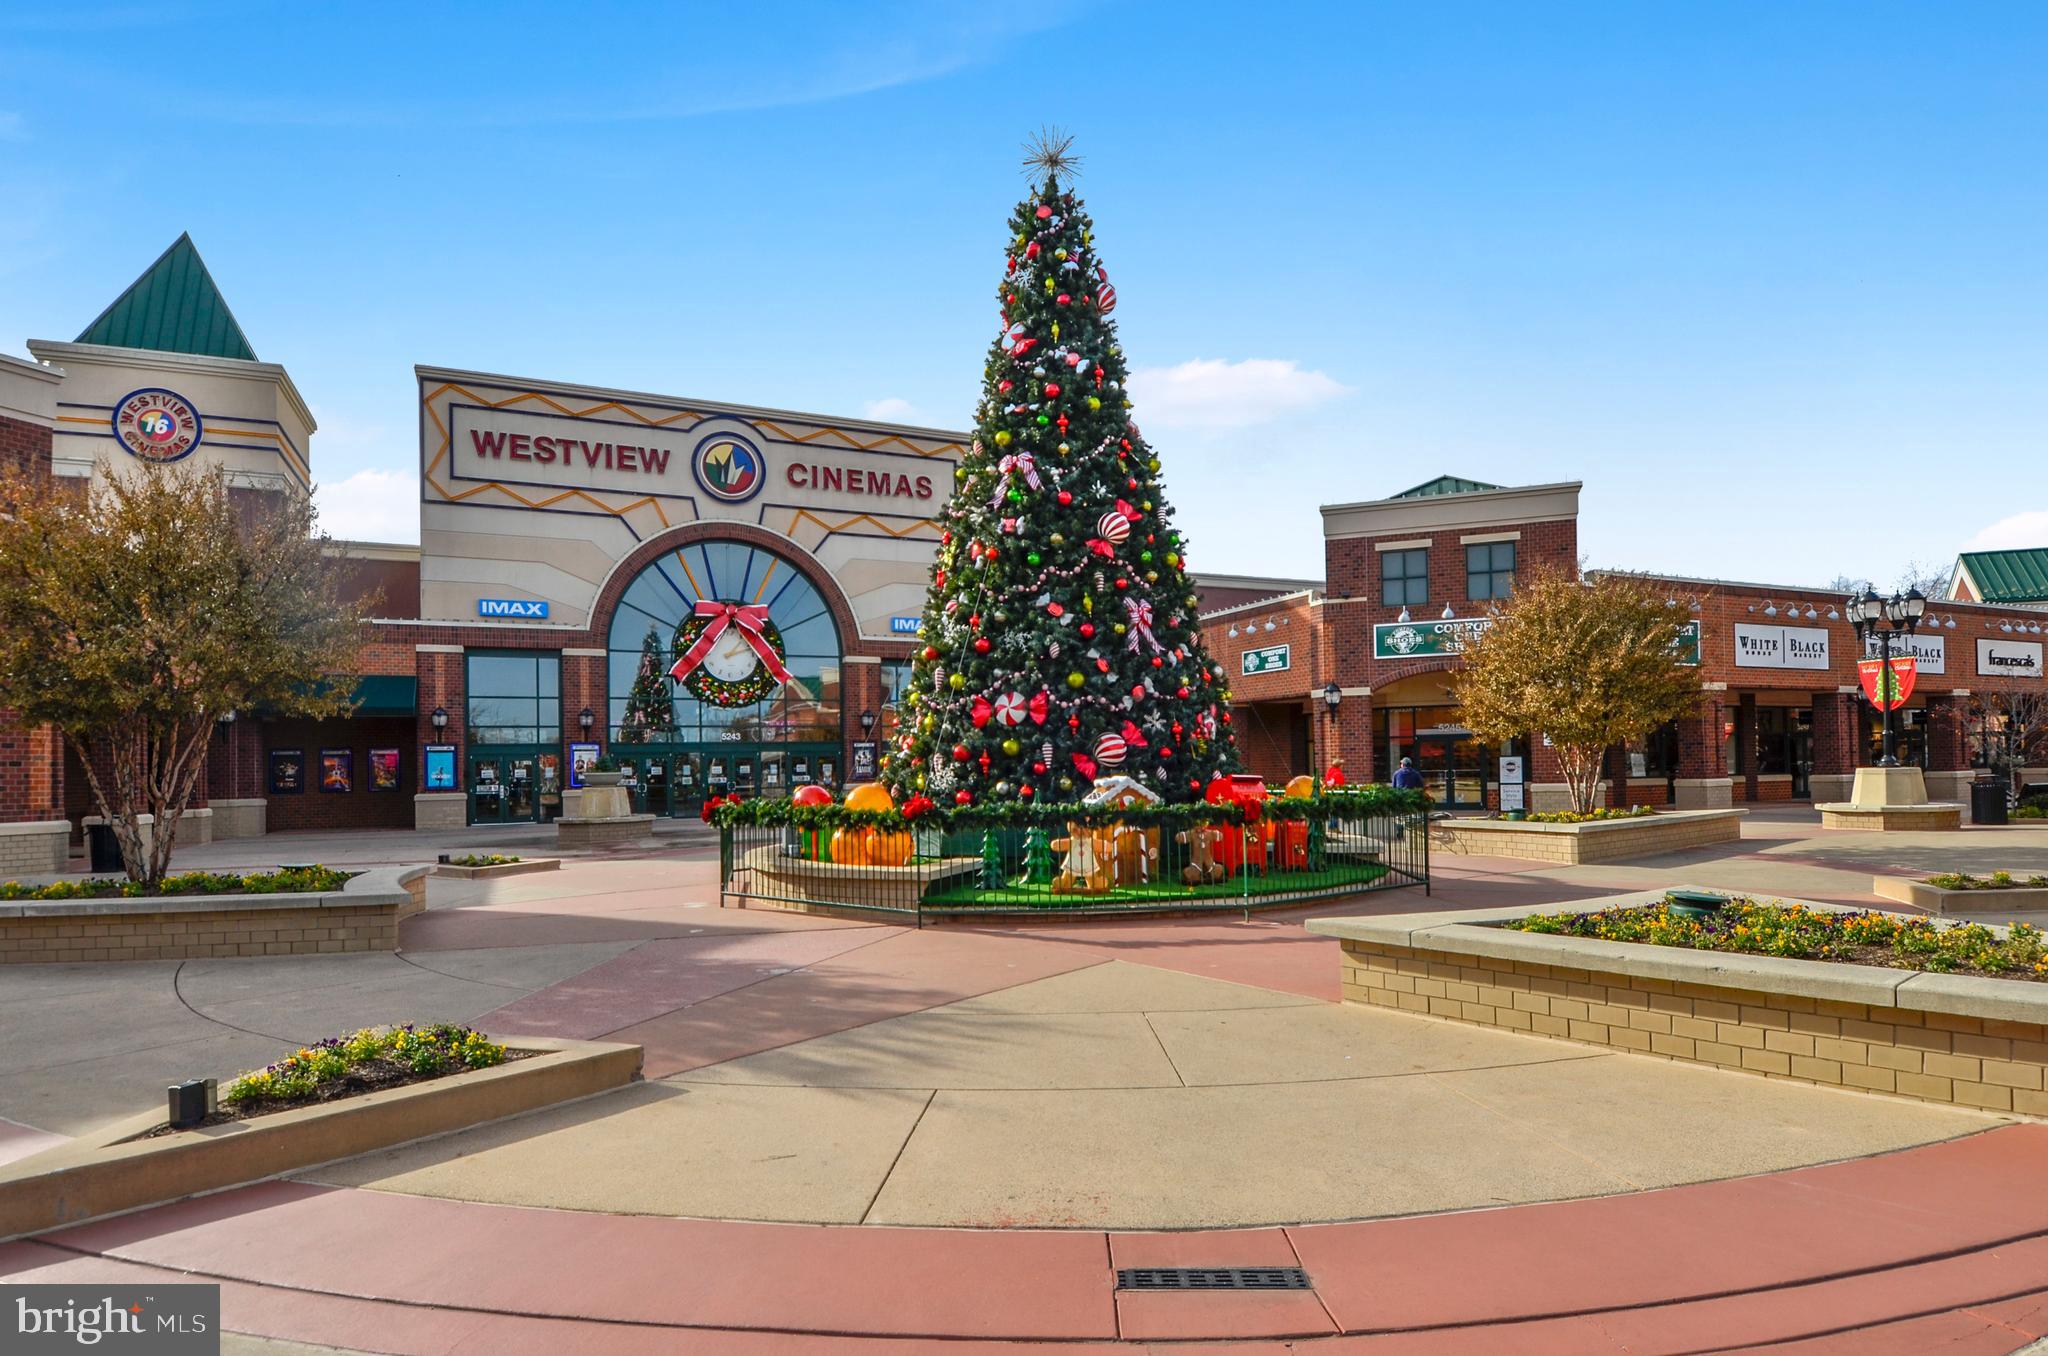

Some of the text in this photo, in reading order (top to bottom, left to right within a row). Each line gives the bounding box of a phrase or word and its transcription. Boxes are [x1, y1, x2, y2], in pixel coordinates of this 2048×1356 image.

[120, 395, 194, 430] WESTVIEW
[145, 416, 169, 435] 16
[124, 431, 190, 457] CINEMAS
[470, 429, 933, 499] WESTVIEW CINEMAS
[482, 601, 543, 616] IMAX
[895, 619, 922, 630] IMA
[1434, 621, 1492, 634] COMFOR
[1386, 636, 1422, 645] SHOES
[1739, 636, 1826, 653] WHITE BLACK
[1912, 645, 1942, 659] BLACK
[1989, 649, 2035, 667] francesca's
[1438, 724, 1461, 732] 5245
[721, 732, 741, 741] 5243
